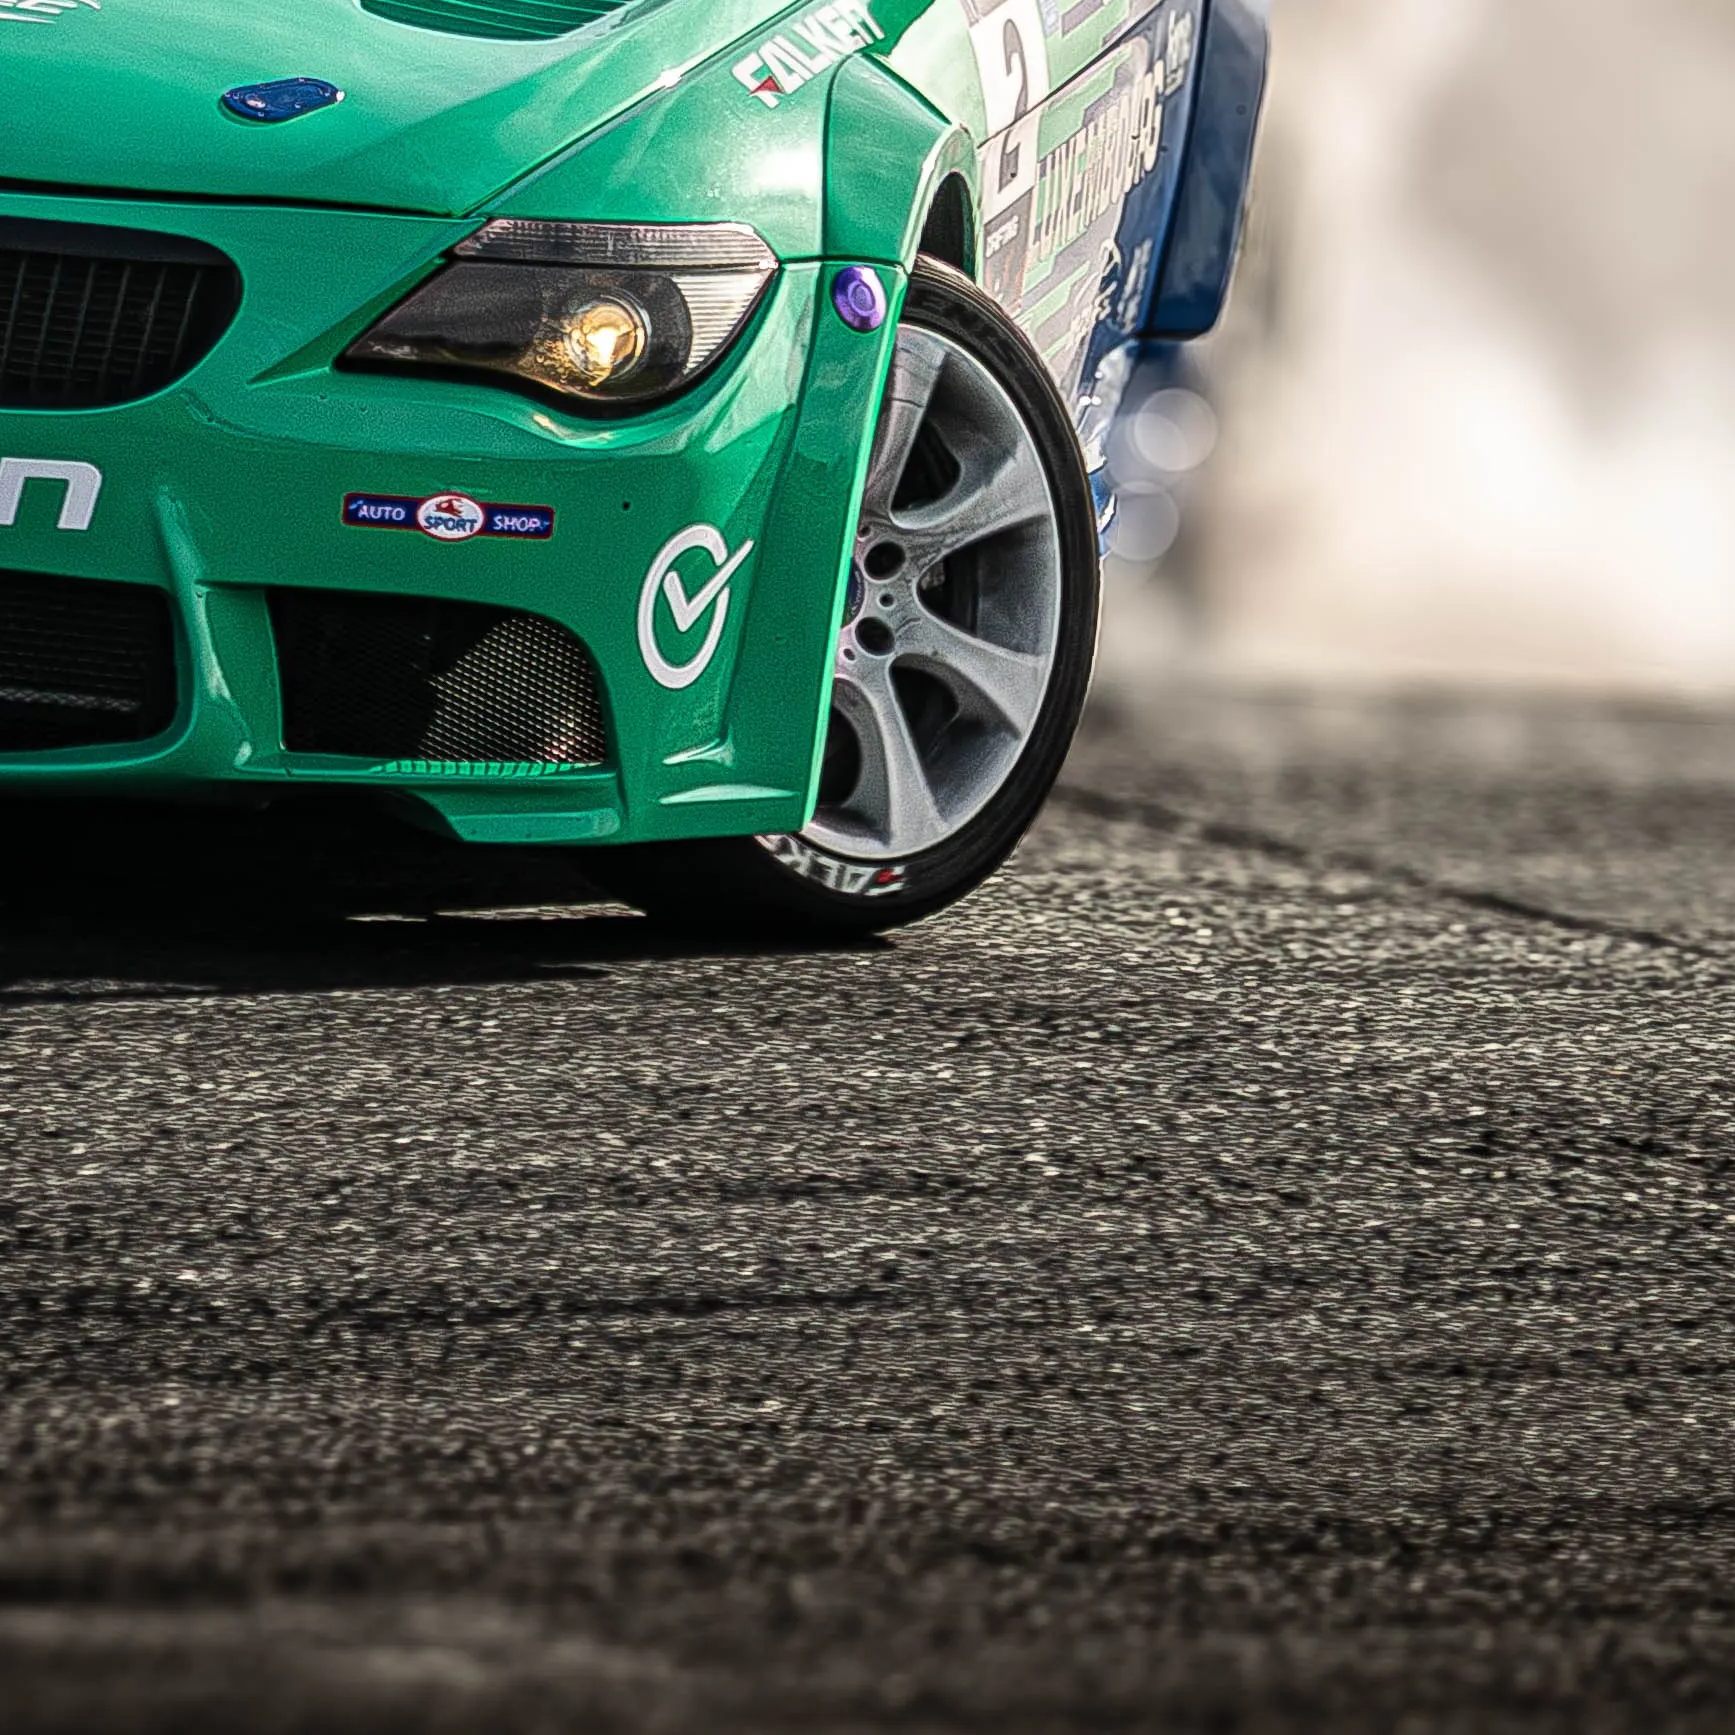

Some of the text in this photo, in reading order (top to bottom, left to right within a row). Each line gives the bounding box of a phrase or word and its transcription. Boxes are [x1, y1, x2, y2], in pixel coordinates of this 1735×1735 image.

[1029, 60, 1163, 265] LUXEMBOURG
[358, 504, 542, 533] AUTO SPORT SHOP
